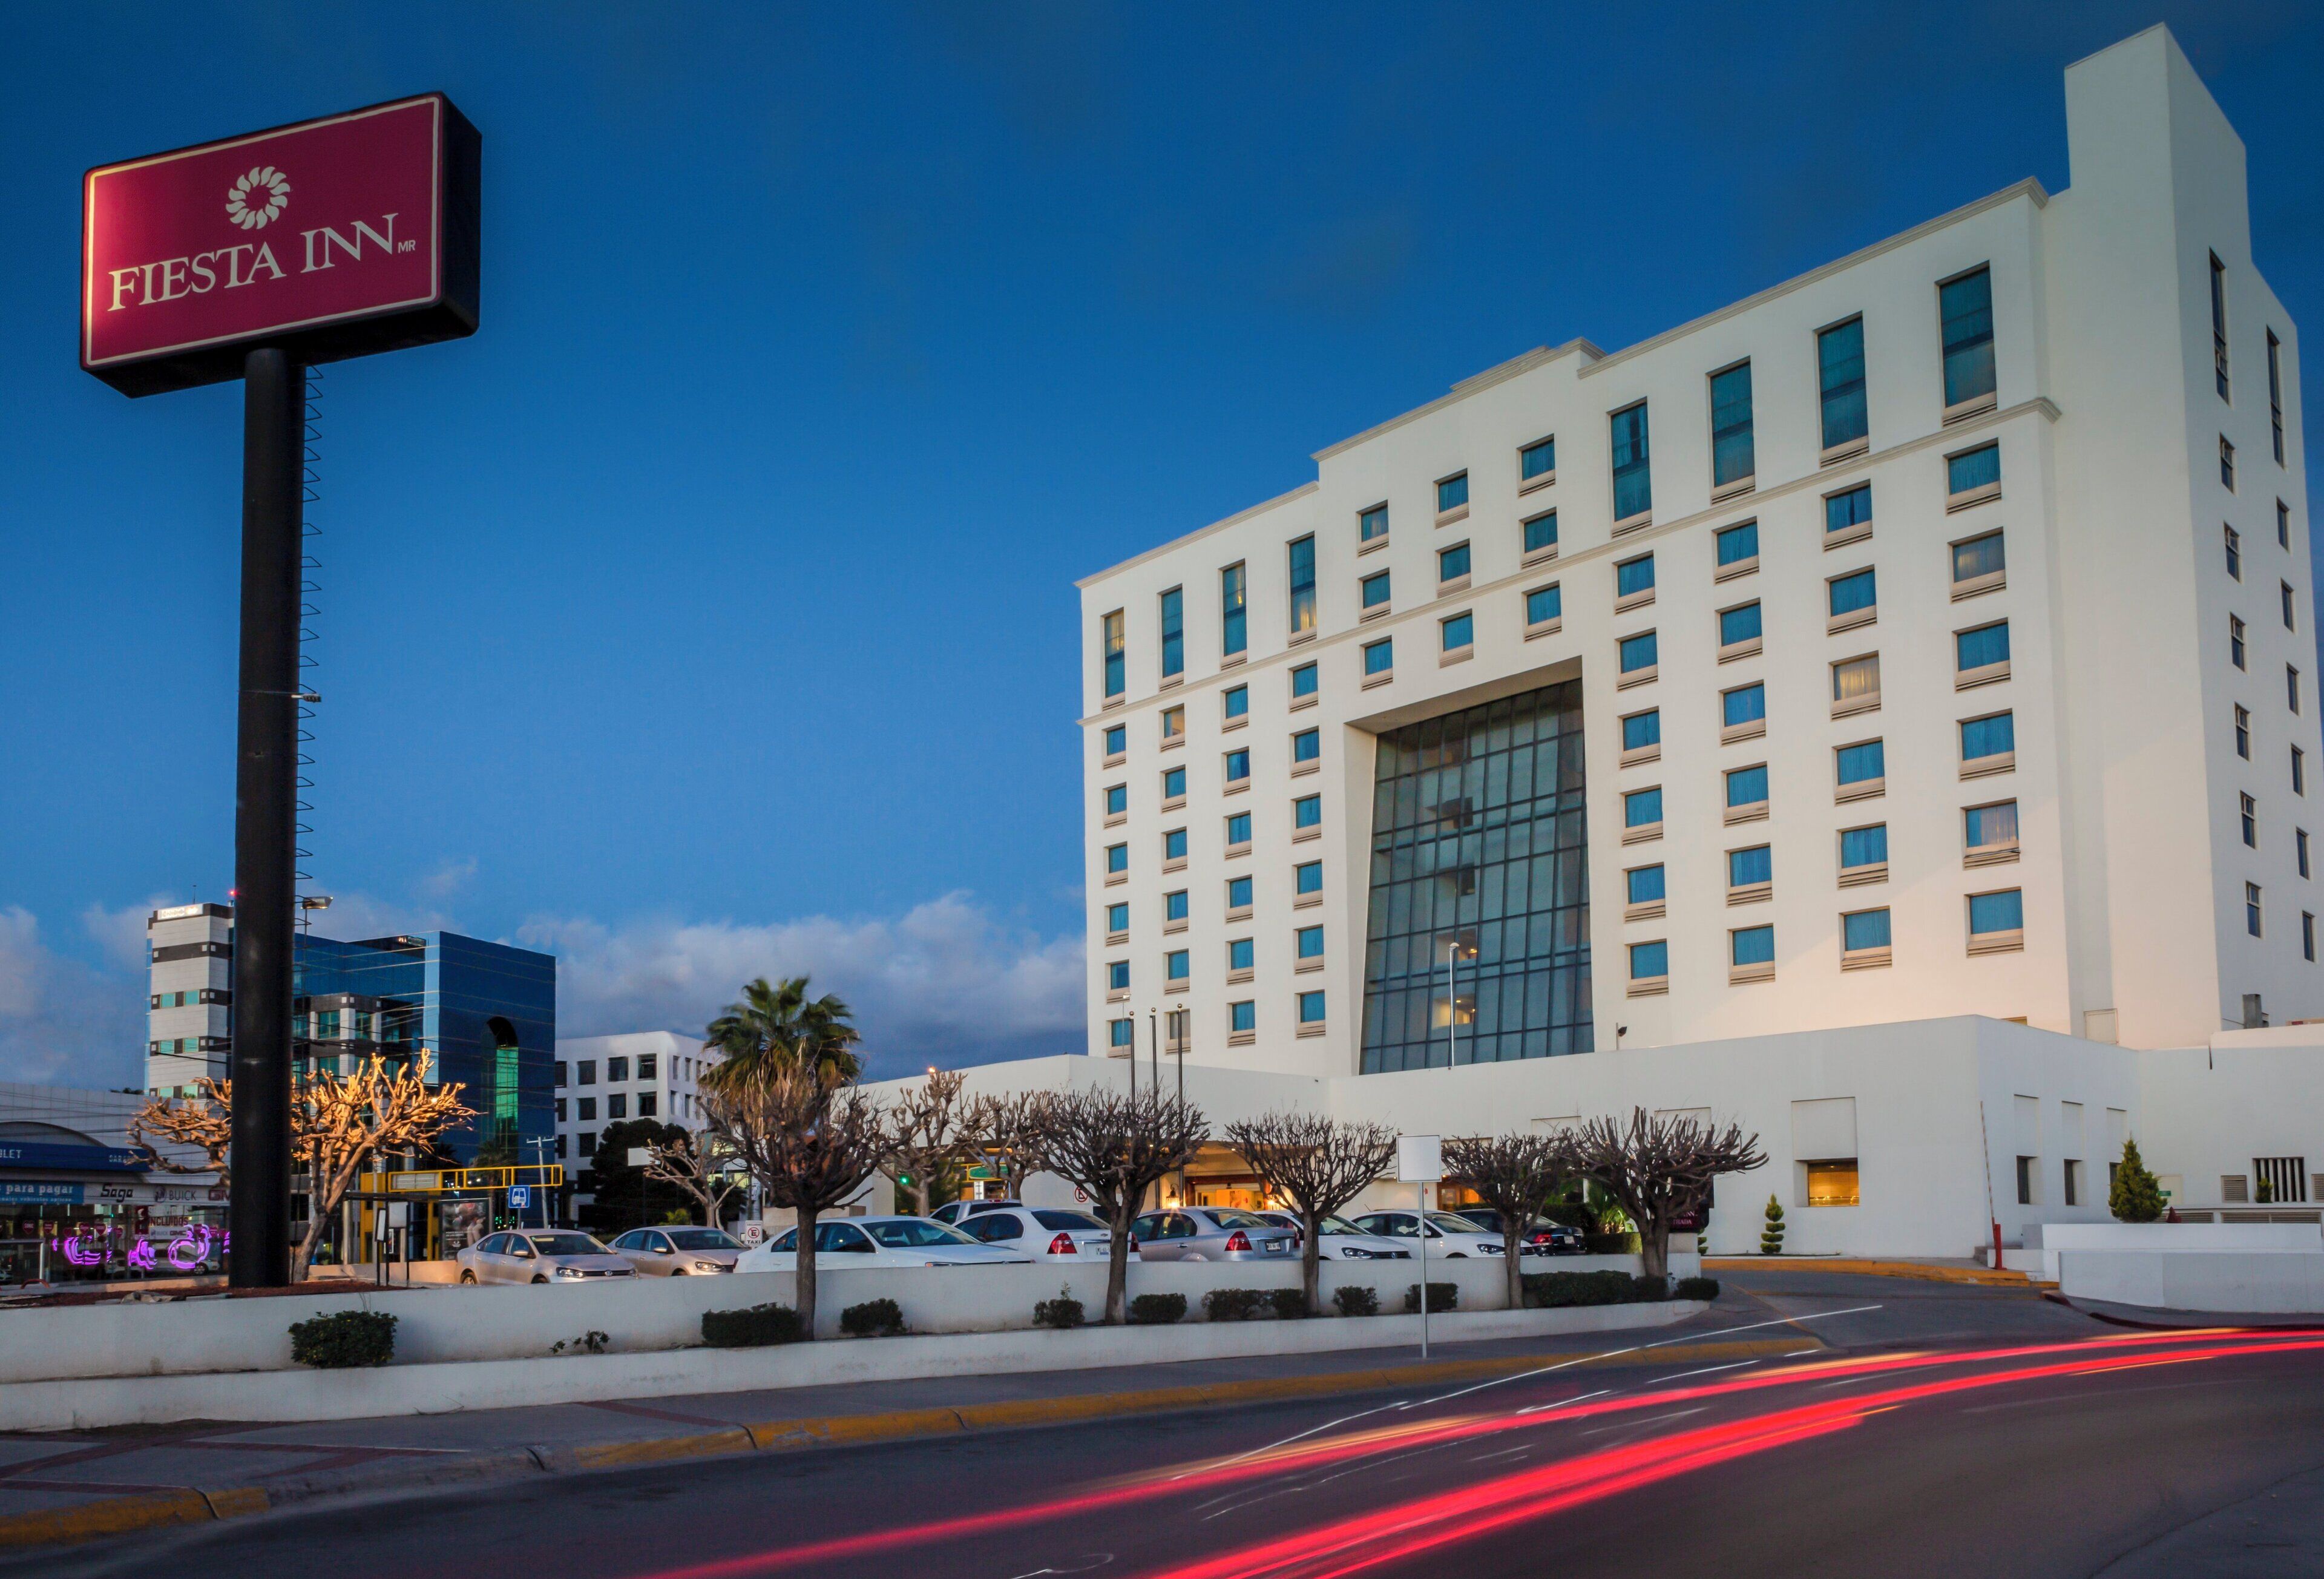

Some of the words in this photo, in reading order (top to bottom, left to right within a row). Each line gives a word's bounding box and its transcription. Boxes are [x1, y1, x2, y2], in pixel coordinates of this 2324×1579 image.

[107, 241, 287, 312] FIESTA
[300, 212, 399, 274] INN
[398, 240, 416, 254] MR
[6, 1184, 34, 1195] para
[39, 1184, 73, 1196] pagar
[169, 1190, 197, 1201] BUICK
[208, 1189, 231, 1202] GM
